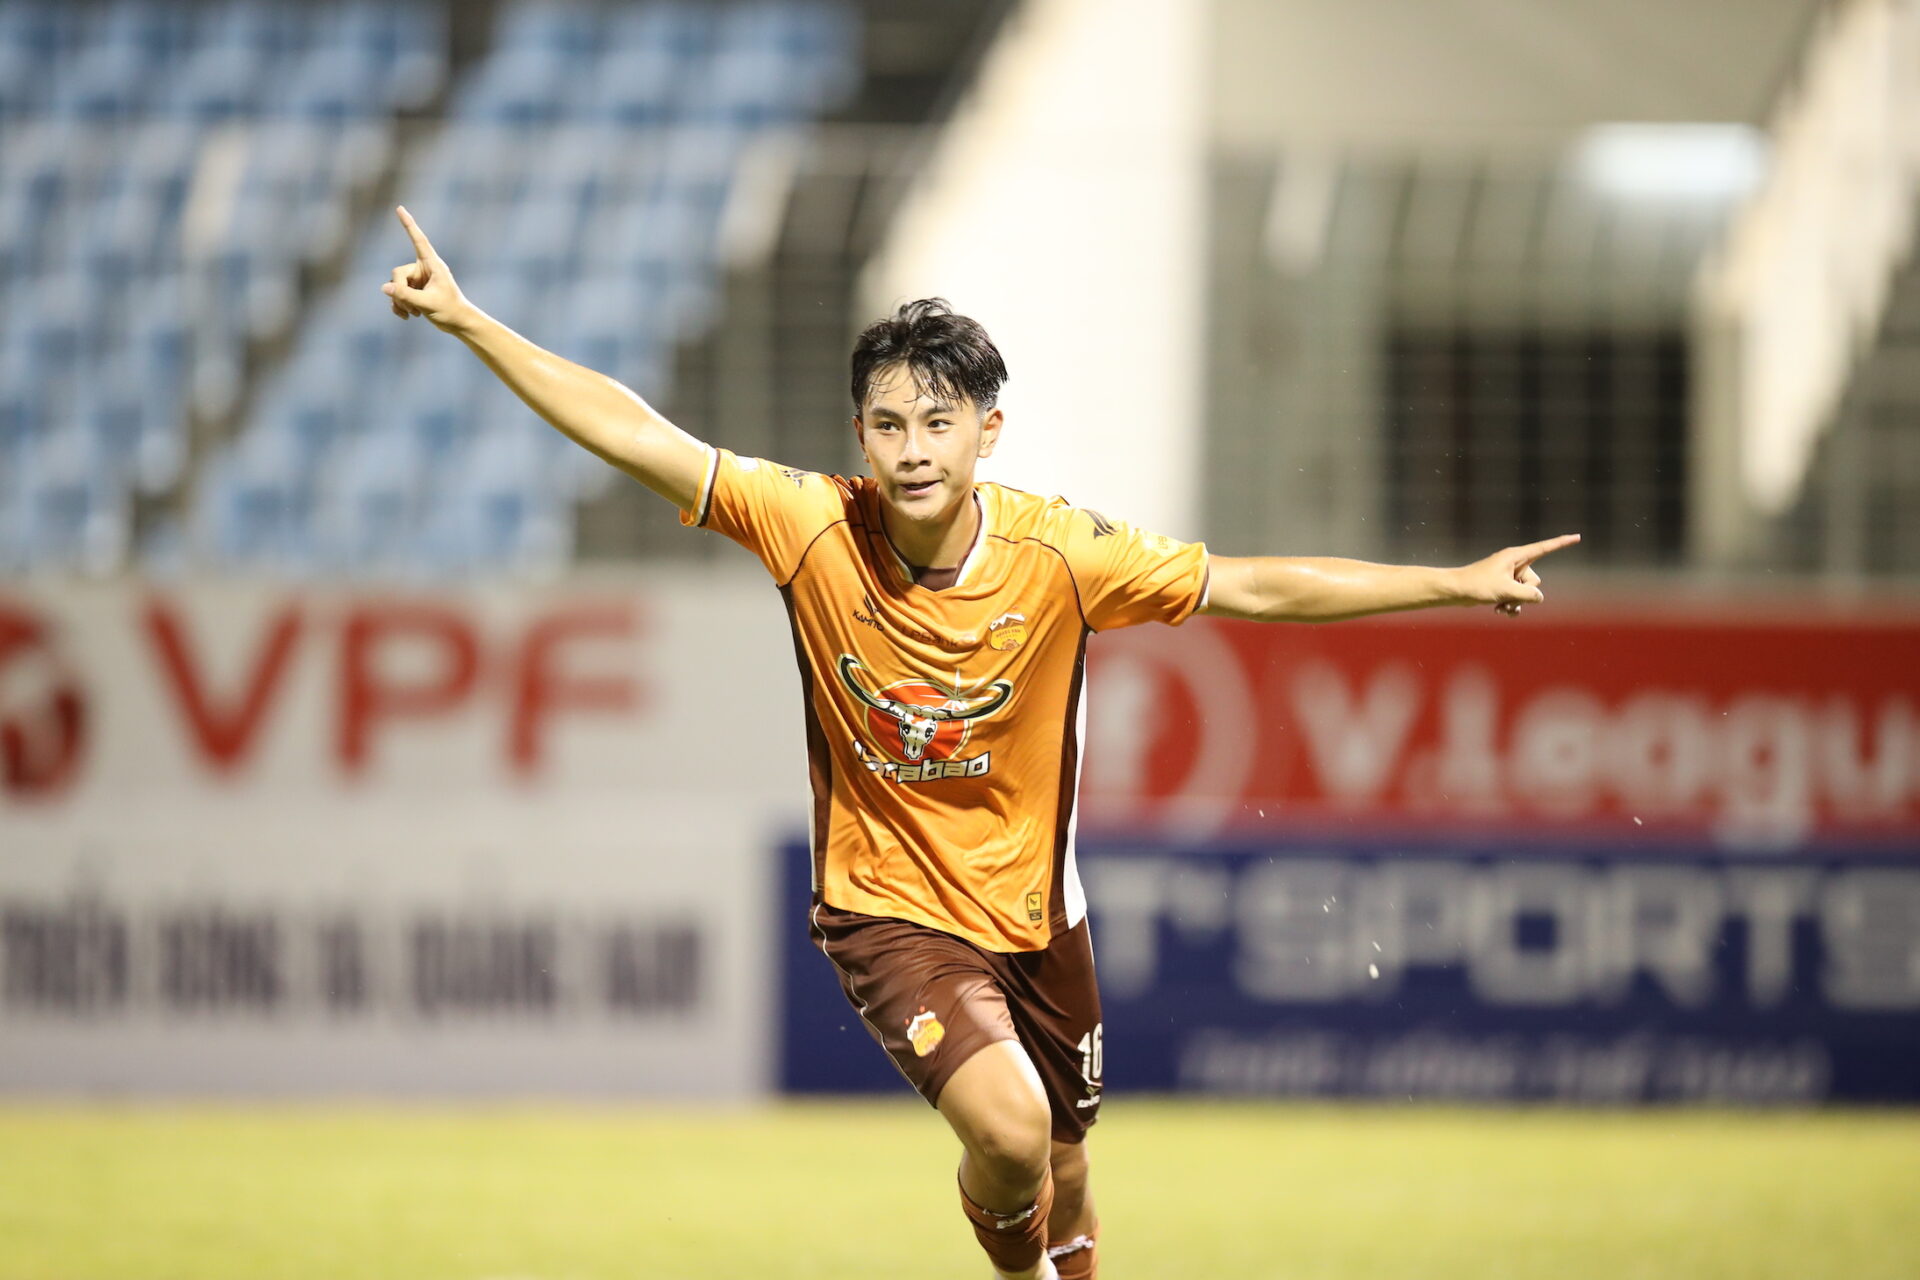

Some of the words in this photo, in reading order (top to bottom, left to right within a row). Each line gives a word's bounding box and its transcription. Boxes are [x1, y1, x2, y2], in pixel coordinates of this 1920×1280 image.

[142, 596, 648, 782] VPF
[1290, 655, 1920, 848] V.Leagu
[1077, 1023, 1103, 1084] 16
